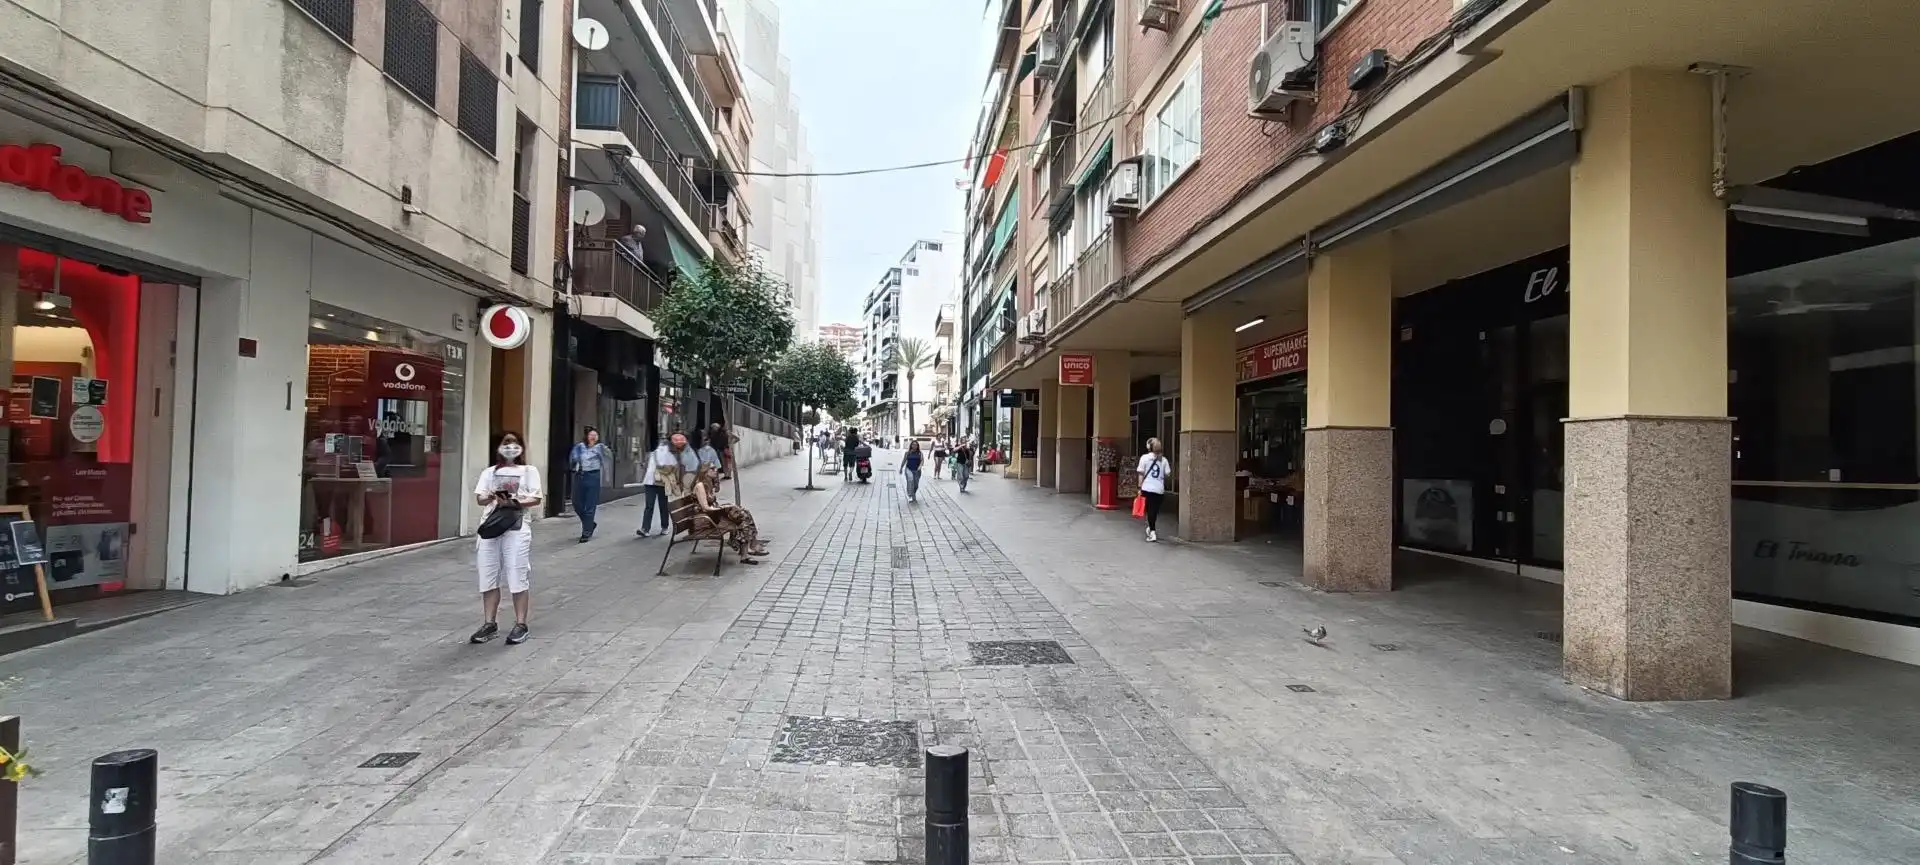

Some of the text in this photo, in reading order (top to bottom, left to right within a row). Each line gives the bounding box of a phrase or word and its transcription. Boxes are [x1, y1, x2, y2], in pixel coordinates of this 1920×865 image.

[1524, 266, 1558, 303] El
[383, 382, 426, 391] vodafone
[1754, 539, 1860, 567] El Triana
